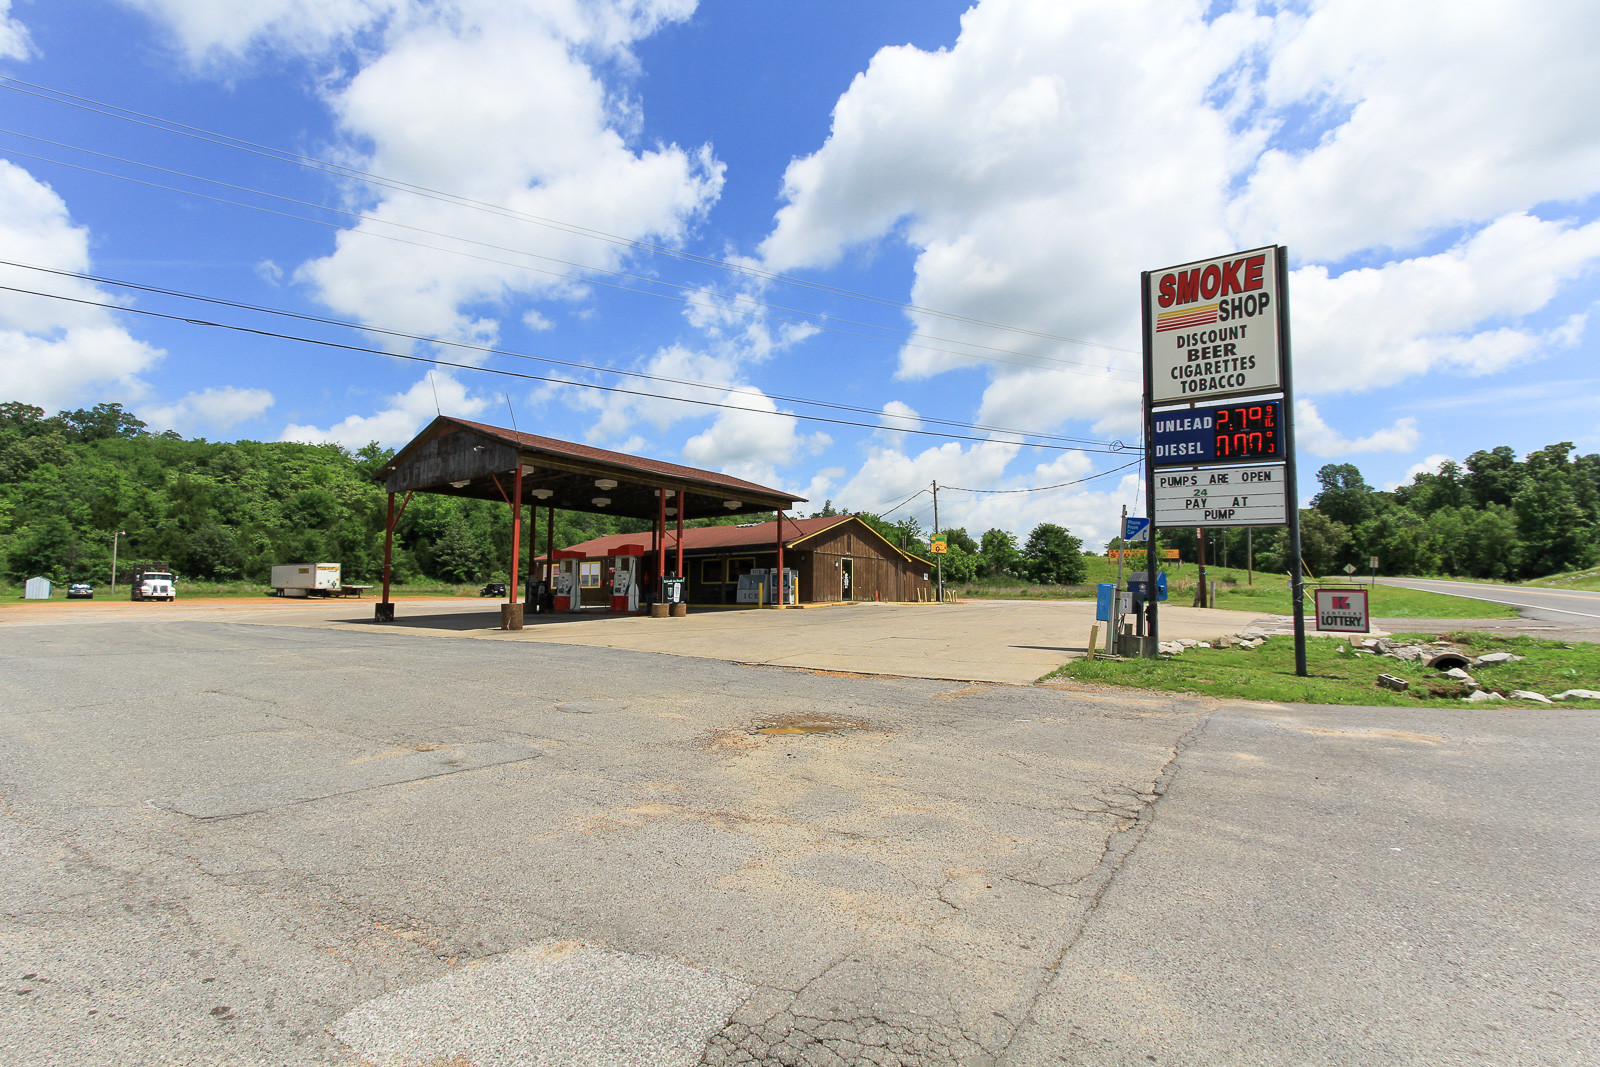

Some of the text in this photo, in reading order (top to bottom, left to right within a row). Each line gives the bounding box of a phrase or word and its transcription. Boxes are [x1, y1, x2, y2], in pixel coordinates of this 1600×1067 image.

[1158, 254, 1266, 308] SMOKE
[1218, 292, 1270, 322] SHOP
[1177, 324, 1247, 349] DISCOUNT
[1187, 342, 1238, 363] BEER
[1171, 355, 1256, 380] CIGARETTES
[1180, 373, 1246, 394] TOBACCO
[1156, 416, 1213, 433] UNLEAD
[1156, 442, 1204, 457] DIESEL
[1160, 471, 1271, 488] PUMPS ARE OPEN
[1193, 488, 1208, 497] 24
[1185, 496, 1248, 509] PAY AT
[1204, 509, 1235, 520] PUMP
[1321, 615, 1363, 627] LOTTERY
